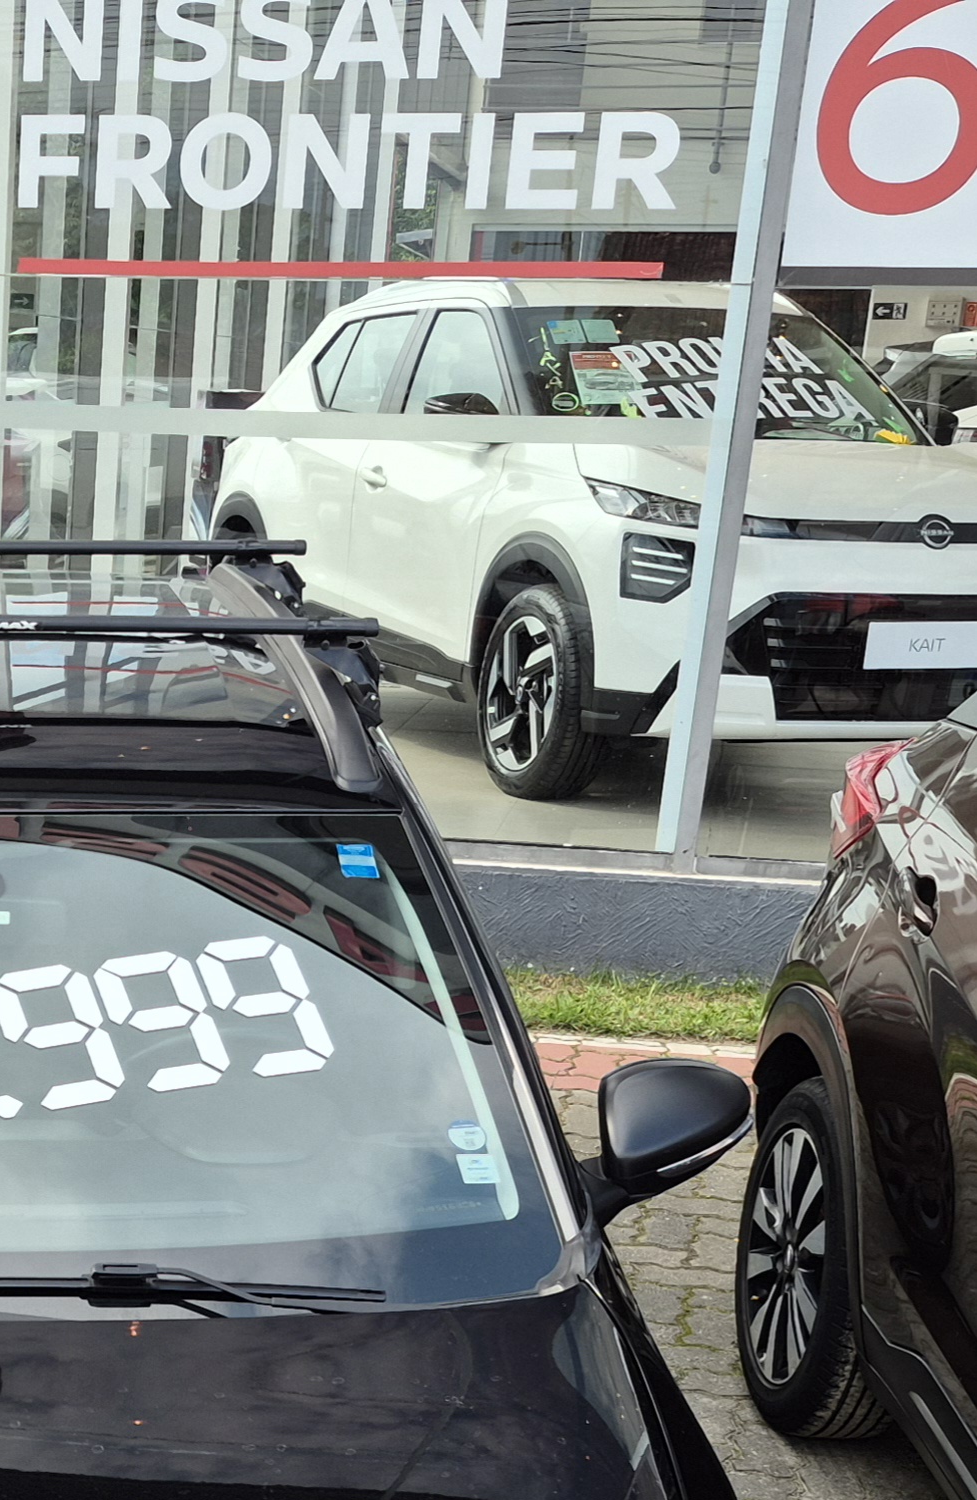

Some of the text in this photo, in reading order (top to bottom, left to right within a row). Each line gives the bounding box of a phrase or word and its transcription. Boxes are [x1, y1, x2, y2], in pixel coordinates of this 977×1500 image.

[21, 0, 508, 82] NISSAN
[17, 111, 681, 211] FRONTIER
[610, 336, 824, 383] PROA
[908, 638, 946, 653] KAIT
